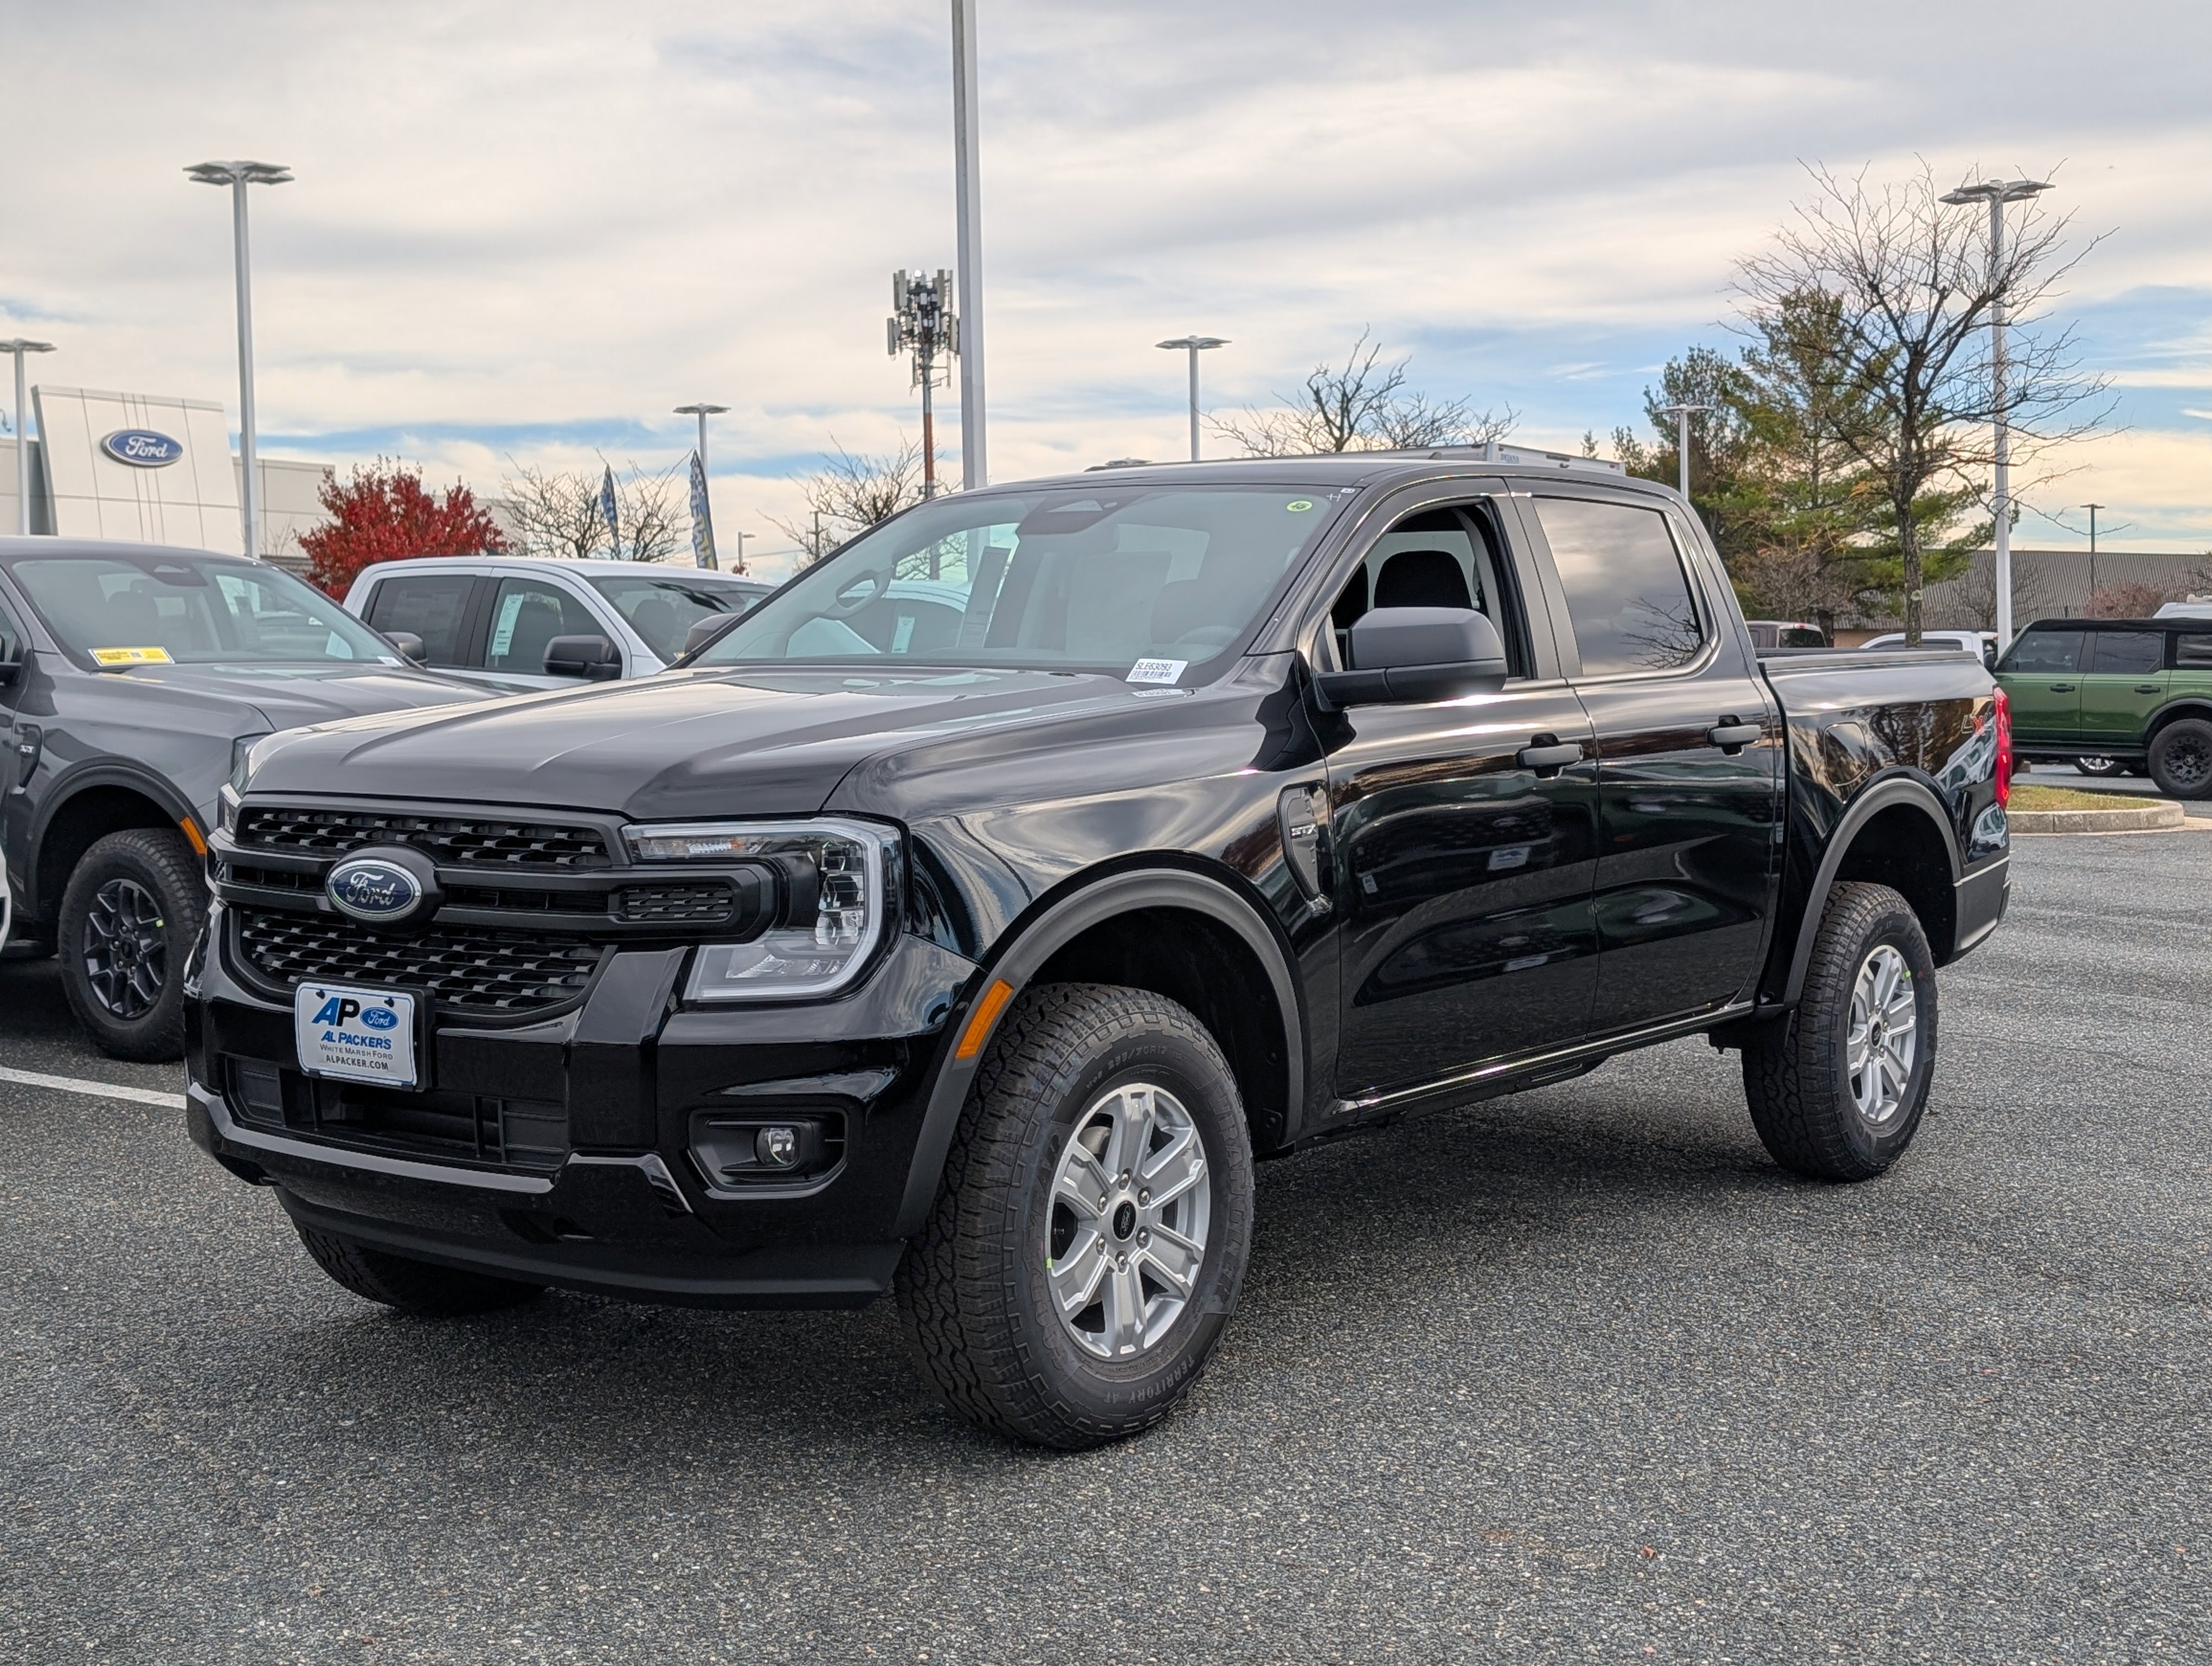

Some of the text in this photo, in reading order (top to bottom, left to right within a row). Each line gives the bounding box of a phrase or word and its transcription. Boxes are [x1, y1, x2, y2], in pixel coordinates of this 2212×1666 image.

[125, 435, 168, 457] Ford
[345, 871, 396, 906] Ford
[311, 997, 361, 1027] AP
[368, 1011, 389, 1026] Ford
[320, 1030, 391, 1050] AL PACKER'S
[319, 1044, 393, 1060] WHITE MARSH FORD
[326, 1055, 388, 1070] ALPACKER.COM
[1208, 1086, 1248, 1301] WRANGLER
[1129, 1354, 1195, 1405] TERRITORY
